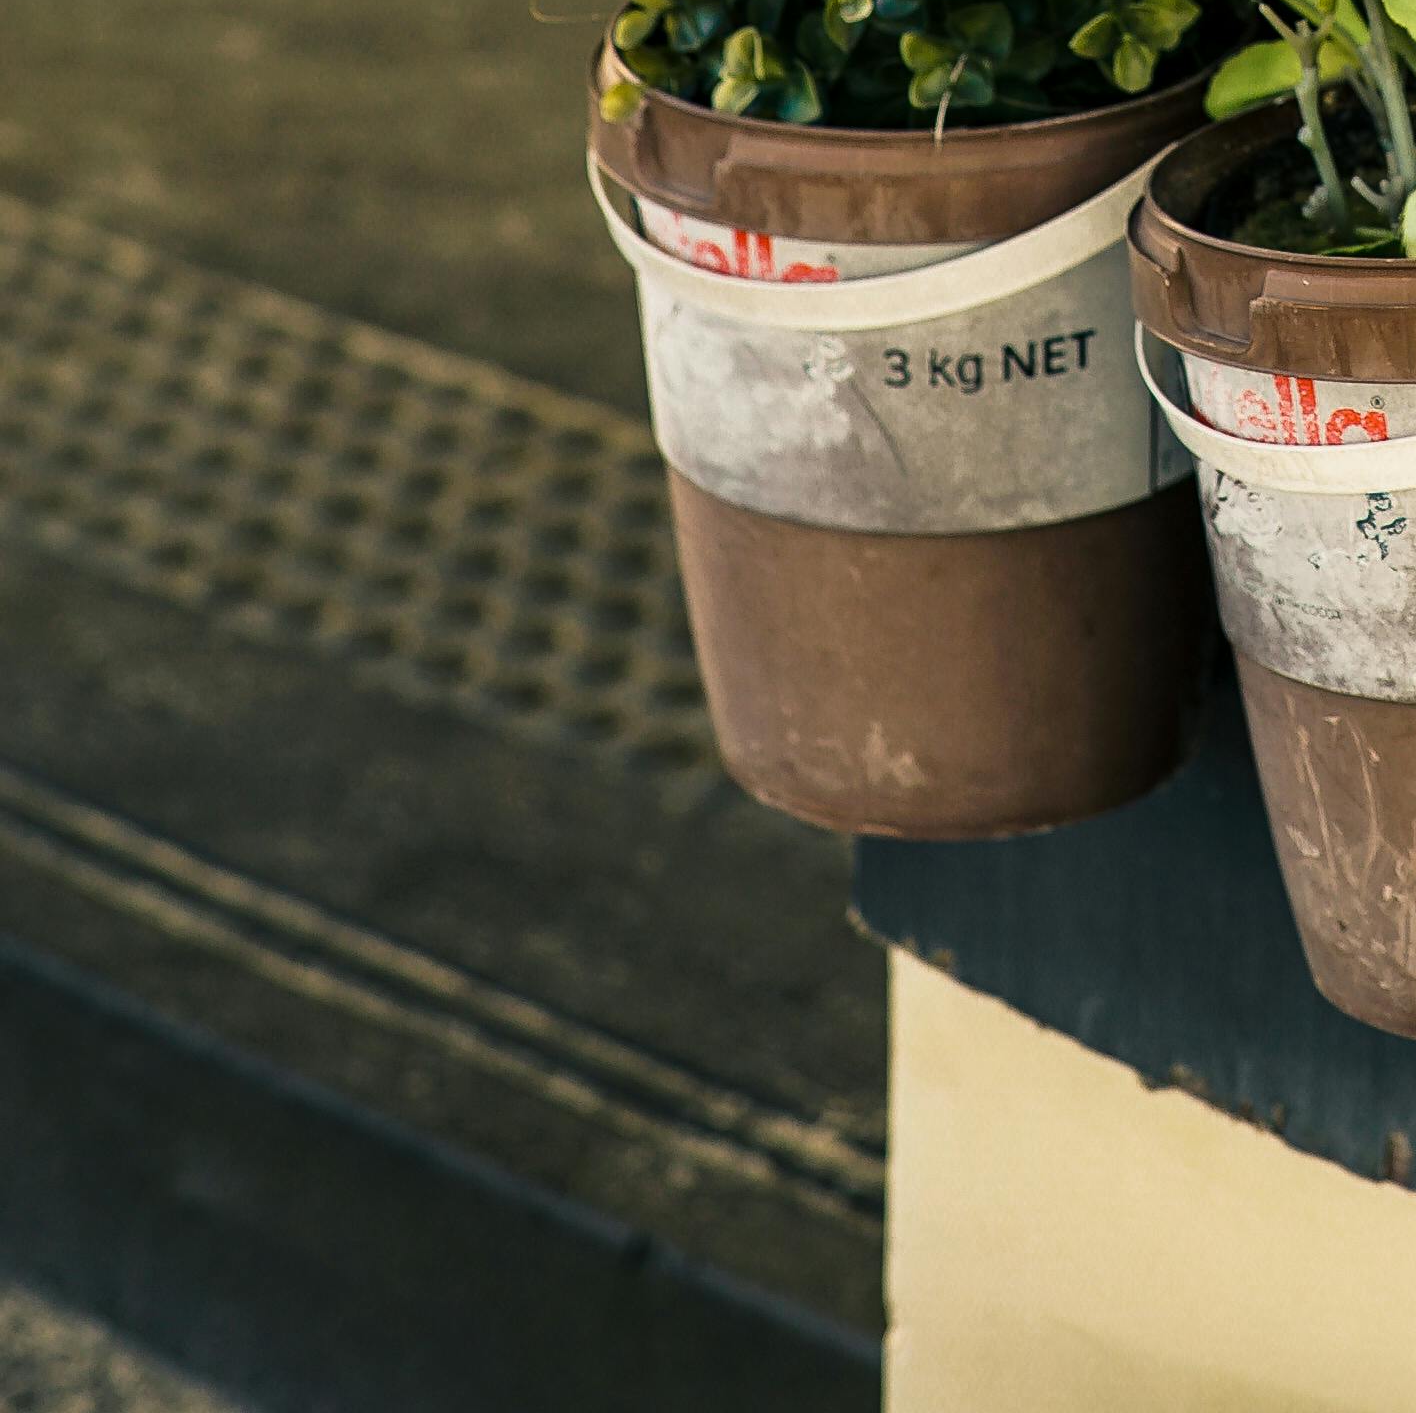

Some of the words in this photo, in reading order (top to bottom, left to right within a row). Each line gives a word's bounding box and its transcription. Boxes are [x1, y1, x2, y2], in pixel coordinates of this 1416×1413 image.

[884, 348, 911, 388] 3
[929, 348, 983, 394] kg
[1003, 329, 1096, 380] NET
